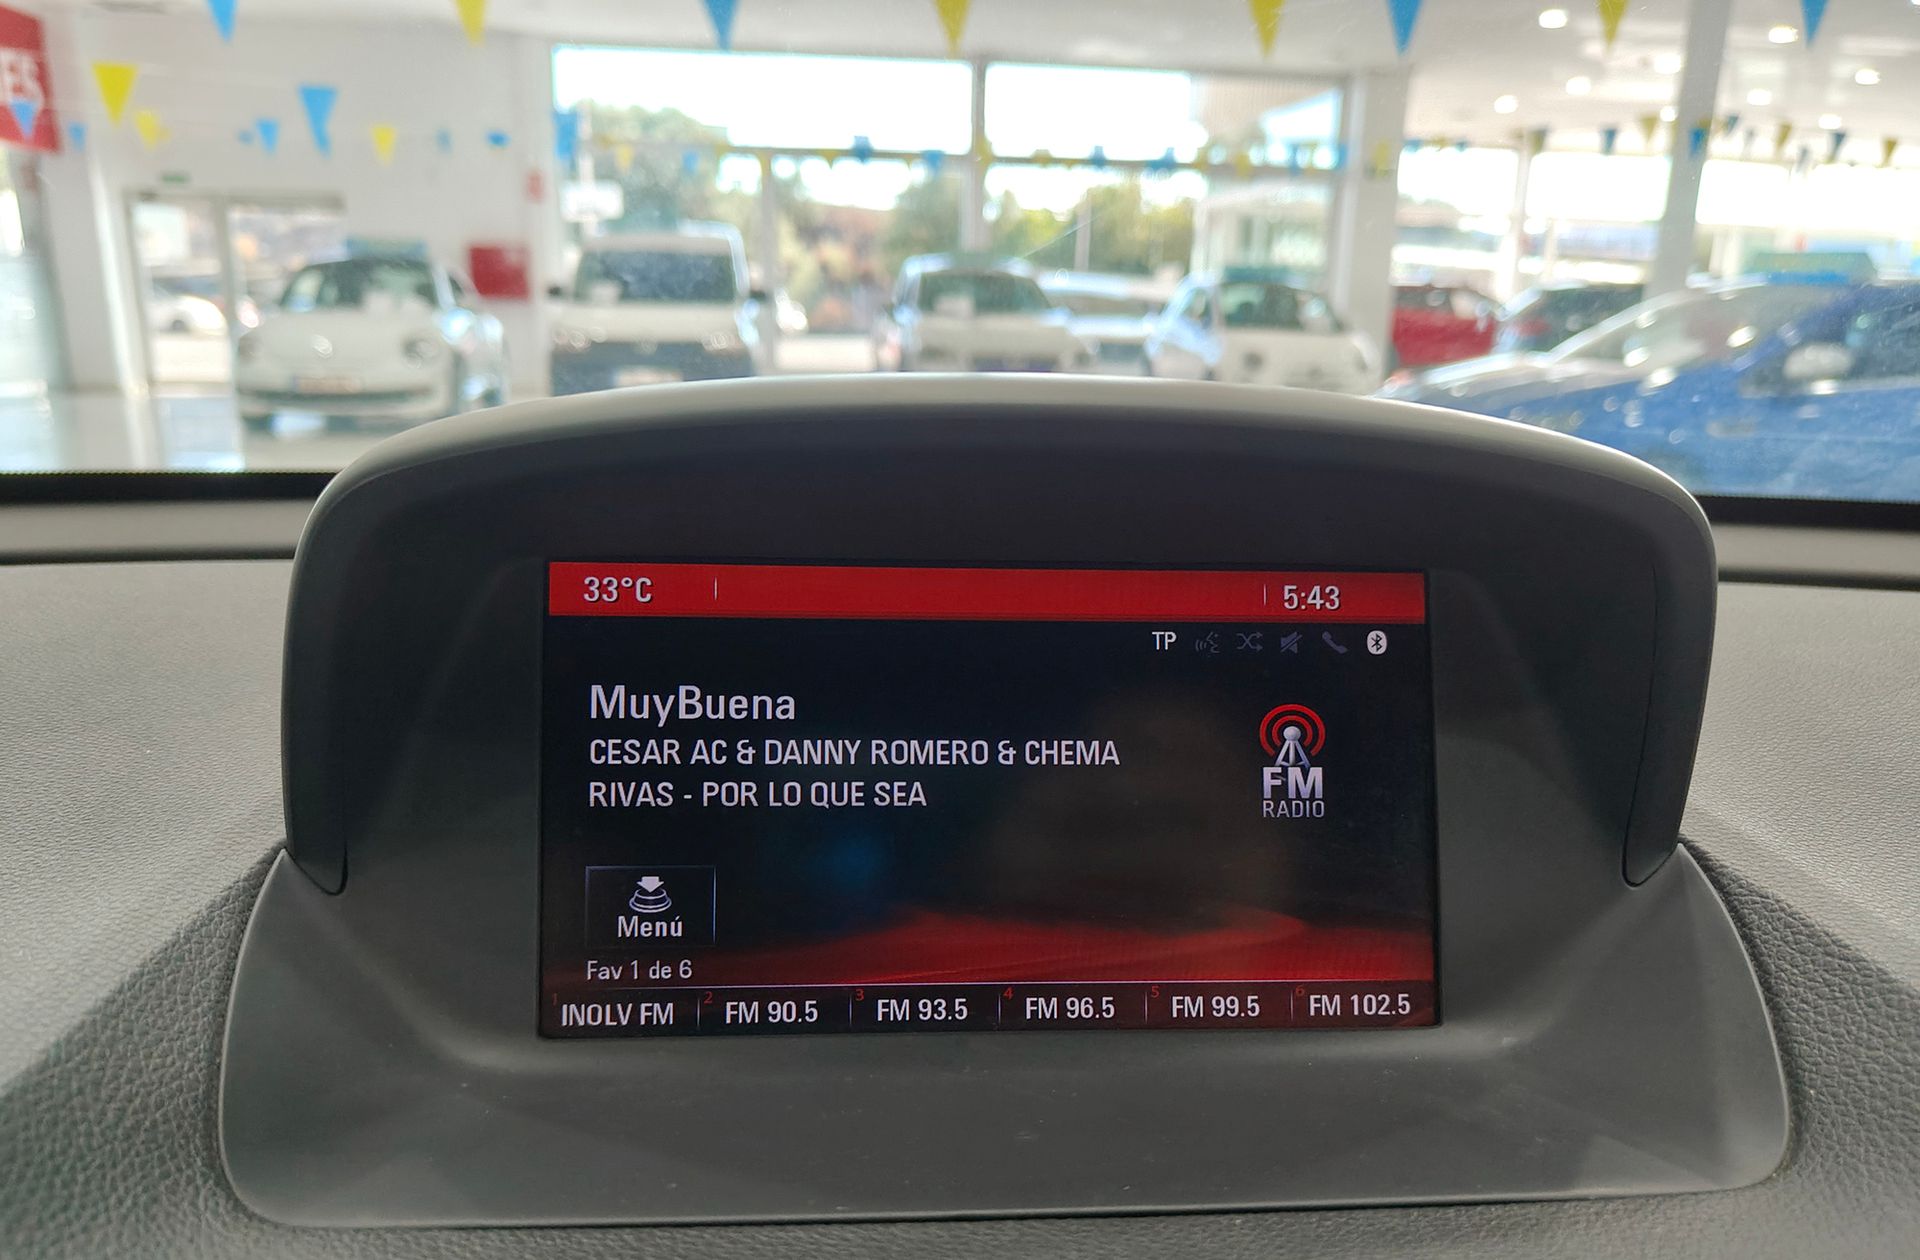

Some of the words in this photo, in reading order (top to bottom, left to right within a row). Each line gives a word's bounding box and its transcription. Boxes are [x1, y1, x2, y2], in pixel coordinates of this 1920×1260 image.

[583, 576, 653, 603] 33°C
[1283, 585, 1341, 611] 5:43
[1152, 631, 1177, 651] TP
[590, 684, 796, 727] MuyBuena
[589, 739, 681, 766] CESAR
[690, 739, 727, 766] AC
[737, 740, 756, 766] &
[764, 740, 861, 766] DANNY
[871, 740, 990, 766] ROMERO
[997, 741, 1017, 766] &
[1024, 740, 1120, 766] CHEMA
[1263, 767, 1323, 799] FM
[589, 781, 674, 808] RIVAS
[702, 781, 758, 808] POR
[769, 782, 801, 808] LO
[811, 782, 864, 809] QUE
[873, 782, 927, 808] SEA
[1262, 801, 1325, 819] RADIO
[617, 915, 683, 938] Menú
[586, 960, 623, 981] Fav
[630, 961, 639, 979] 1
[648, 960, 672, 980] de
[679, 960, 692, 979] 6
[704, 991, 713, 1004] 2
[855, 989, 865, 1002] 3
[1003, 987, 1014, 1000] 4
[1151, 986, 1160, 998] 5
[561, 1003, 632, 1026] INOLV
[640, 1003, 674, 1025] FM
[725, 1002, 759, 1024] FM
[767, 1001, 819, 1024] 90.5
[876, 1000, 910, 1022] FM
[918, 999, 969, 1022] 93.5
[1025, 998, 1058, 1020] FM
[1066, 997, 1115, 1020] 96.5
[1171, 997, 1205, 1018] FM
[1211, 996, 1260, 1018] 99.5
[1309, 995, 1342, 1016] FM
[1349, 994, 1411, 1016] 102.5
